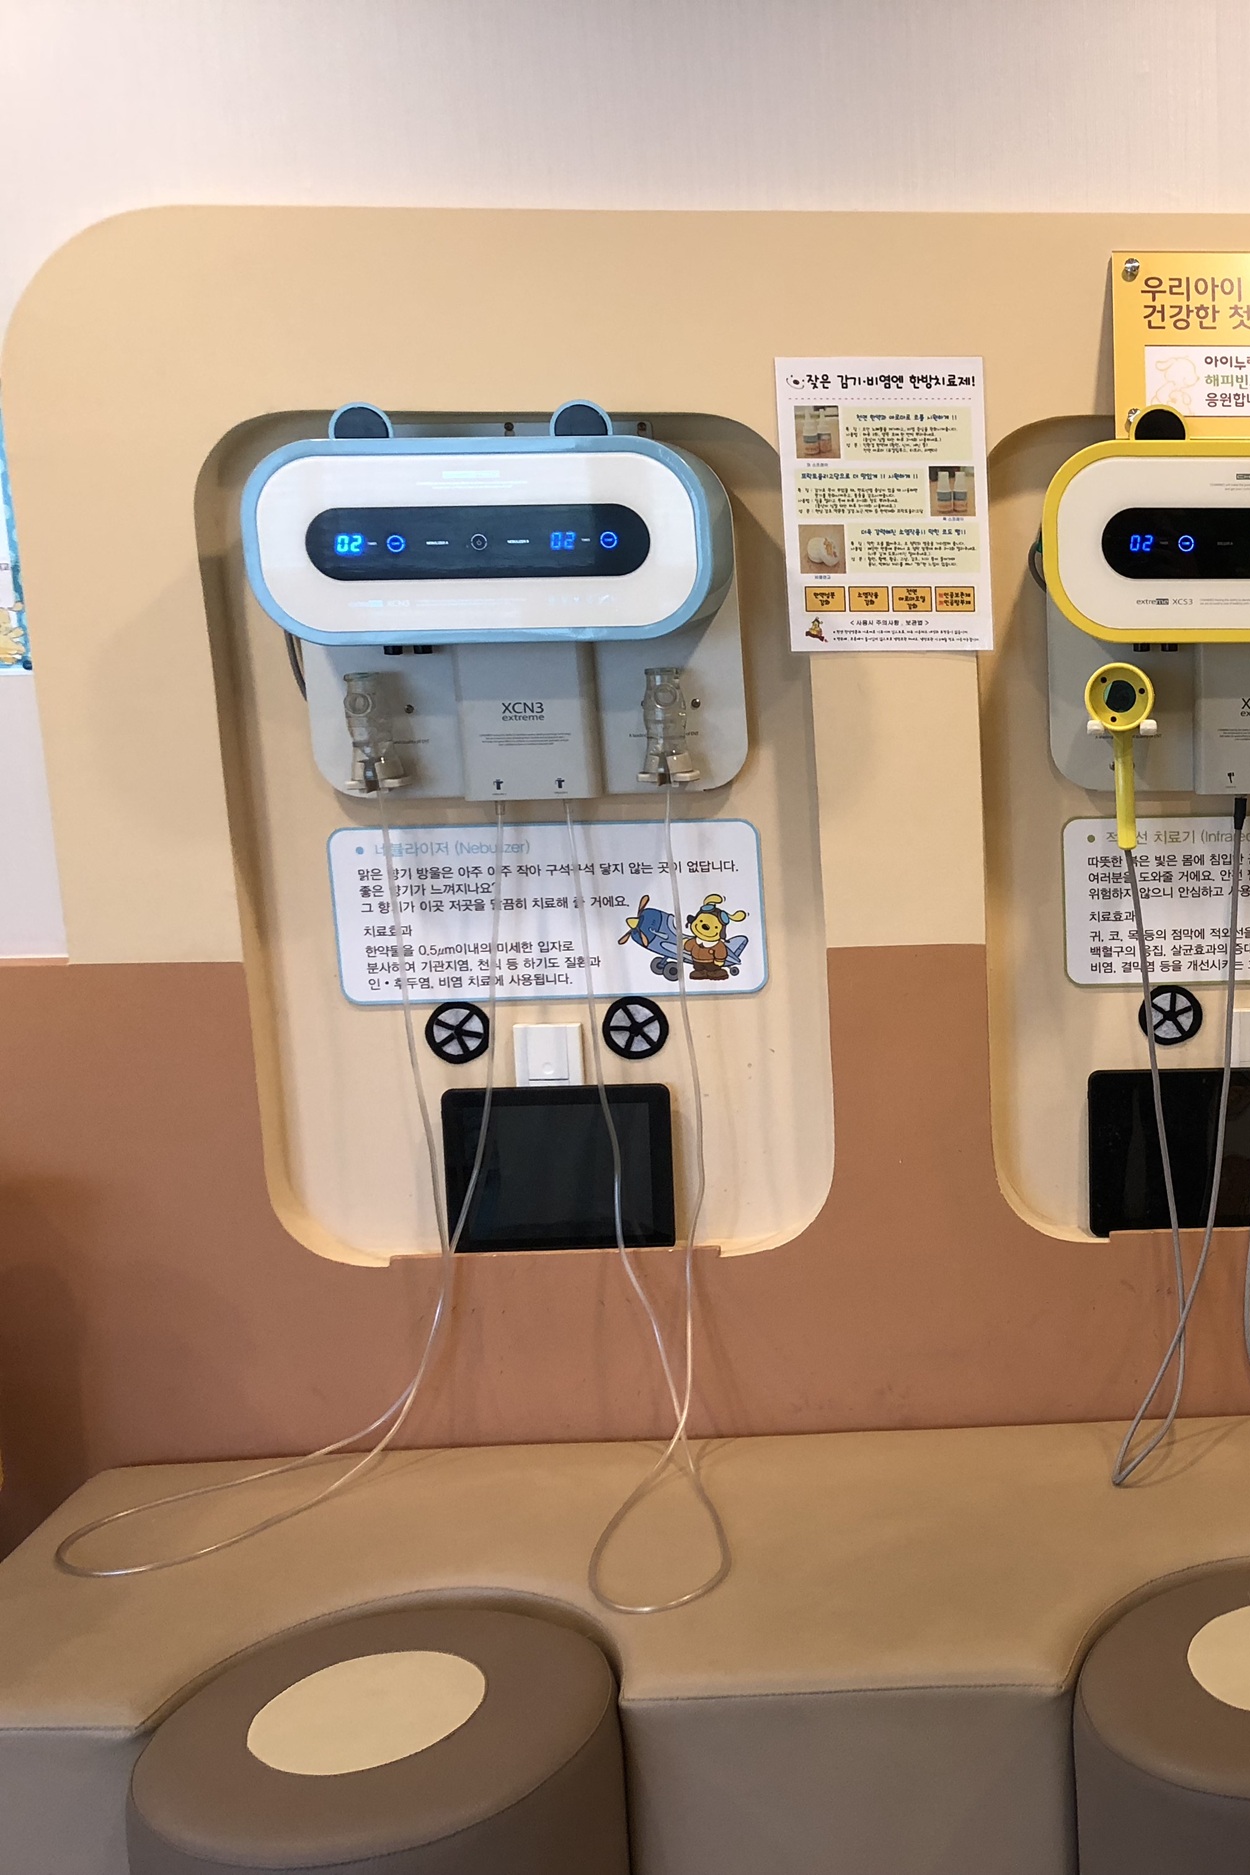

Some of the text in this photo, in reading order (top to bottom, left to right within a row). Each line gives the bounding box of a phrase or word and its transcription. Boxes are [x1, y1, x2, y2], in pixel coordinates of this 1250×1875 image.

[1140, 276, 1243, 302] 우리아이
[1143, 304, 1220, 331] 건강한
[806, 373, 832, 390] 잦은
[909, 373, 976, 390] 한방치료제!
[337, 534, 362, 553] 02
[550, 531, 576, 550] 02
[1129, 534, 1154, 552] 02
[501, 702, 545, 714] XCN3
[501, 714, 545, 722] extreme
[1105, 830, 1148, 846] 적선
[1153, 830, 1196, 845] 치료기
[454, 839, 531, 856] (Nebuzer)
[1087, 855, 1123, 869] 따뜻한
[1154, 854, 1178, 867] 빛은
[1181, 853, 1205, 866] 몸에
[357, 867, 384, 882] 맑은
[416, 866, 454, 880] 방울은
[457, 865, 483, 879] 아주
[516, 863, 542, 877] 작아
[599, 862, 625, 876] 닿지
[628, 861, 654, 876] 않는
[656, 860, 682, 875] 곳이
[686, 859, 739, 874] 없답니다.
[1088, 871, 1132, 885] 여러분을
[1138, 870, 1174, 883] 도와줄
[1178, 870, 1215, 882] 거에요.
[358, 884, 385, 898] 좋은
[430, 881, 497, 896] 느껴지나요
[1139, 886, 1174, 900] 않으니
[1178, 885, 1224, 899] 안심하고
[360, 902, 374, 913] 그
[419, 900, 445, 913] 이곳
[448, 899, 486, 912] 저곳을
[531, 896, 569, 910] 치료해
[590, 895, 630, 908] 거에요.
[1089, 910, 1136, 923] 치료효과
[363, 924, 413, 938] 치료효과
[1127, 929, 1139, 941] 목
[1143, 928, 1167, 941] 등의
[1170, 927, 1205, 941] 점막에
[496, 941, 533, 955] 미세한
[537, 941, 575, 953] 입자로
[1089, 945, 1136, 958] 백혈구의
[1170, 943, 1228, 957] 살균효과의
[506, 958, 519, 971] 등
[523, 957, 560, 970] 하기도
[564, 955, 602, 969] 질환과
[1159, 960, 1183, 973] 등을
[438, 976, 463, 989] 비염
[467, 974, 505, 988] 치료에
[508, 971, 574, 987] 사용됩니다.
